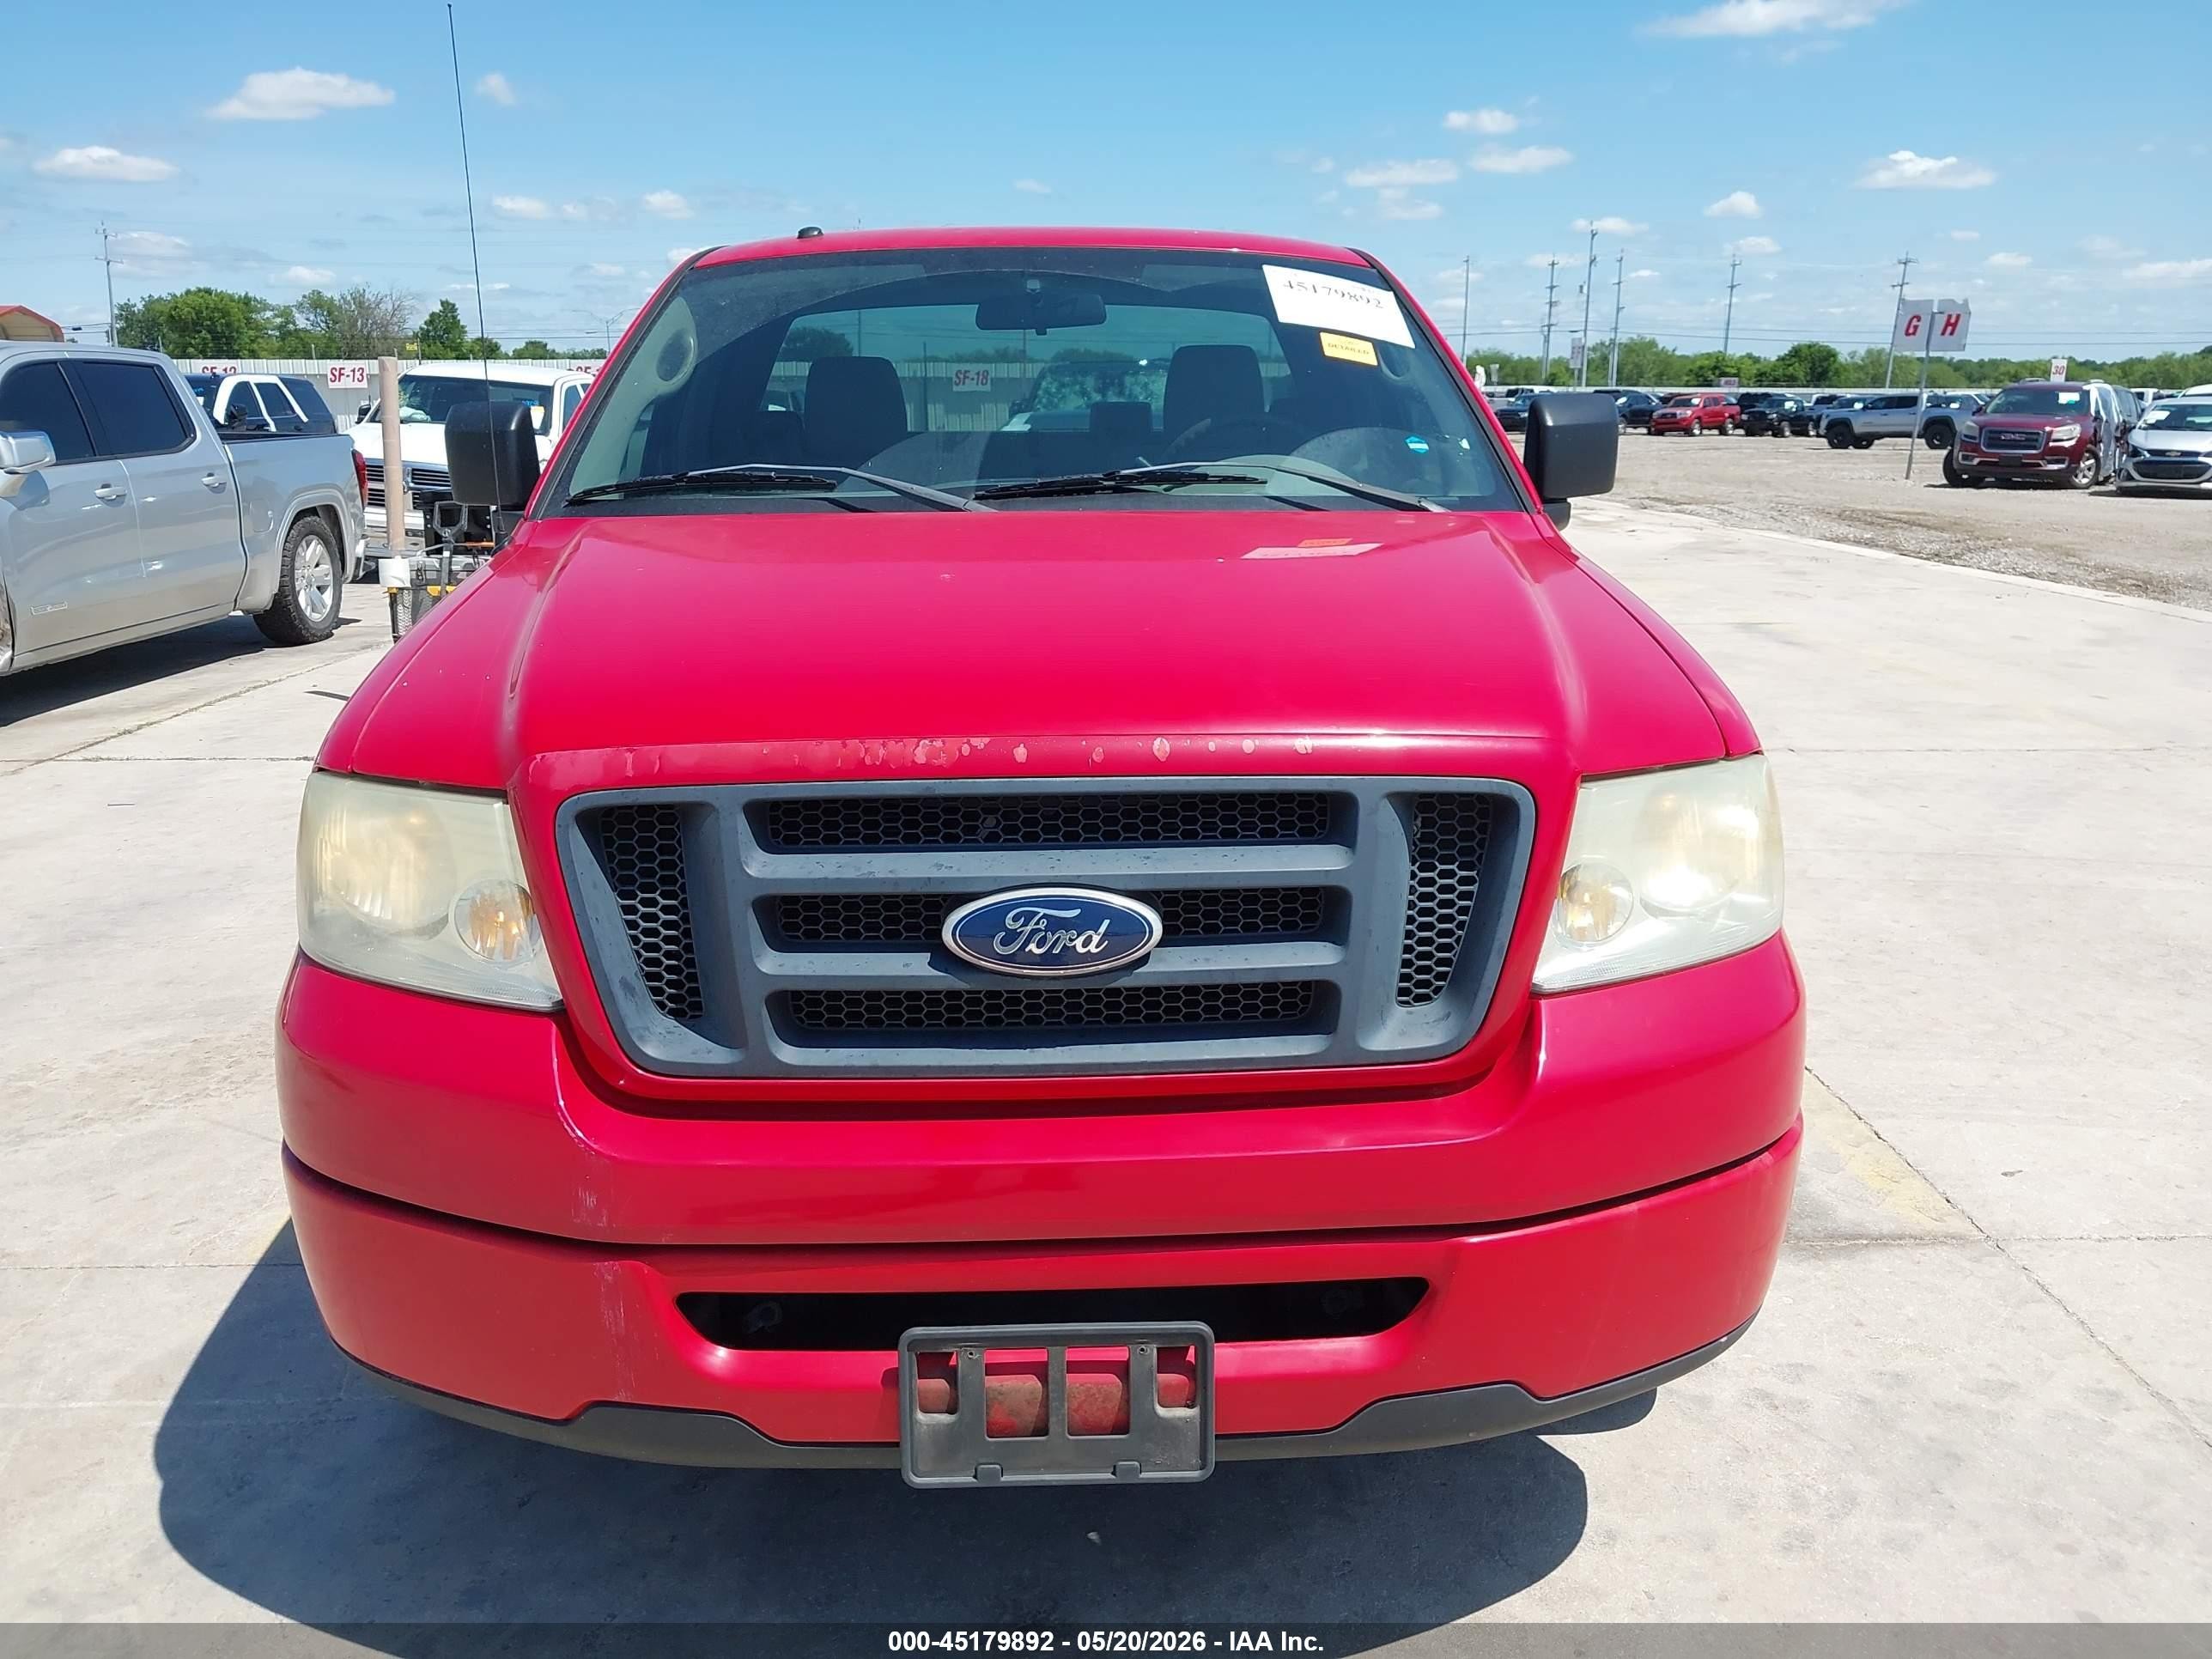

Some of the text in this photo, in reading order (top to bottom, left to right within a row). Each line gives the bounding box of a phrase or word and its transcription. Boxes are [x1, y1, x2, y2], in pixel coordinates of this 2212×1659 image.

[1283, 279, 1384, 309] 45179892
[1904, 314, 1922, 337] G
[1940, 313, 1961, 336] H
[329, 367, 365, 383] SF-13
[954, 369, 989, 386] SF-18
[2052, 364, 2065, 375] 30
[993, 907, 1111, 955] Ford
